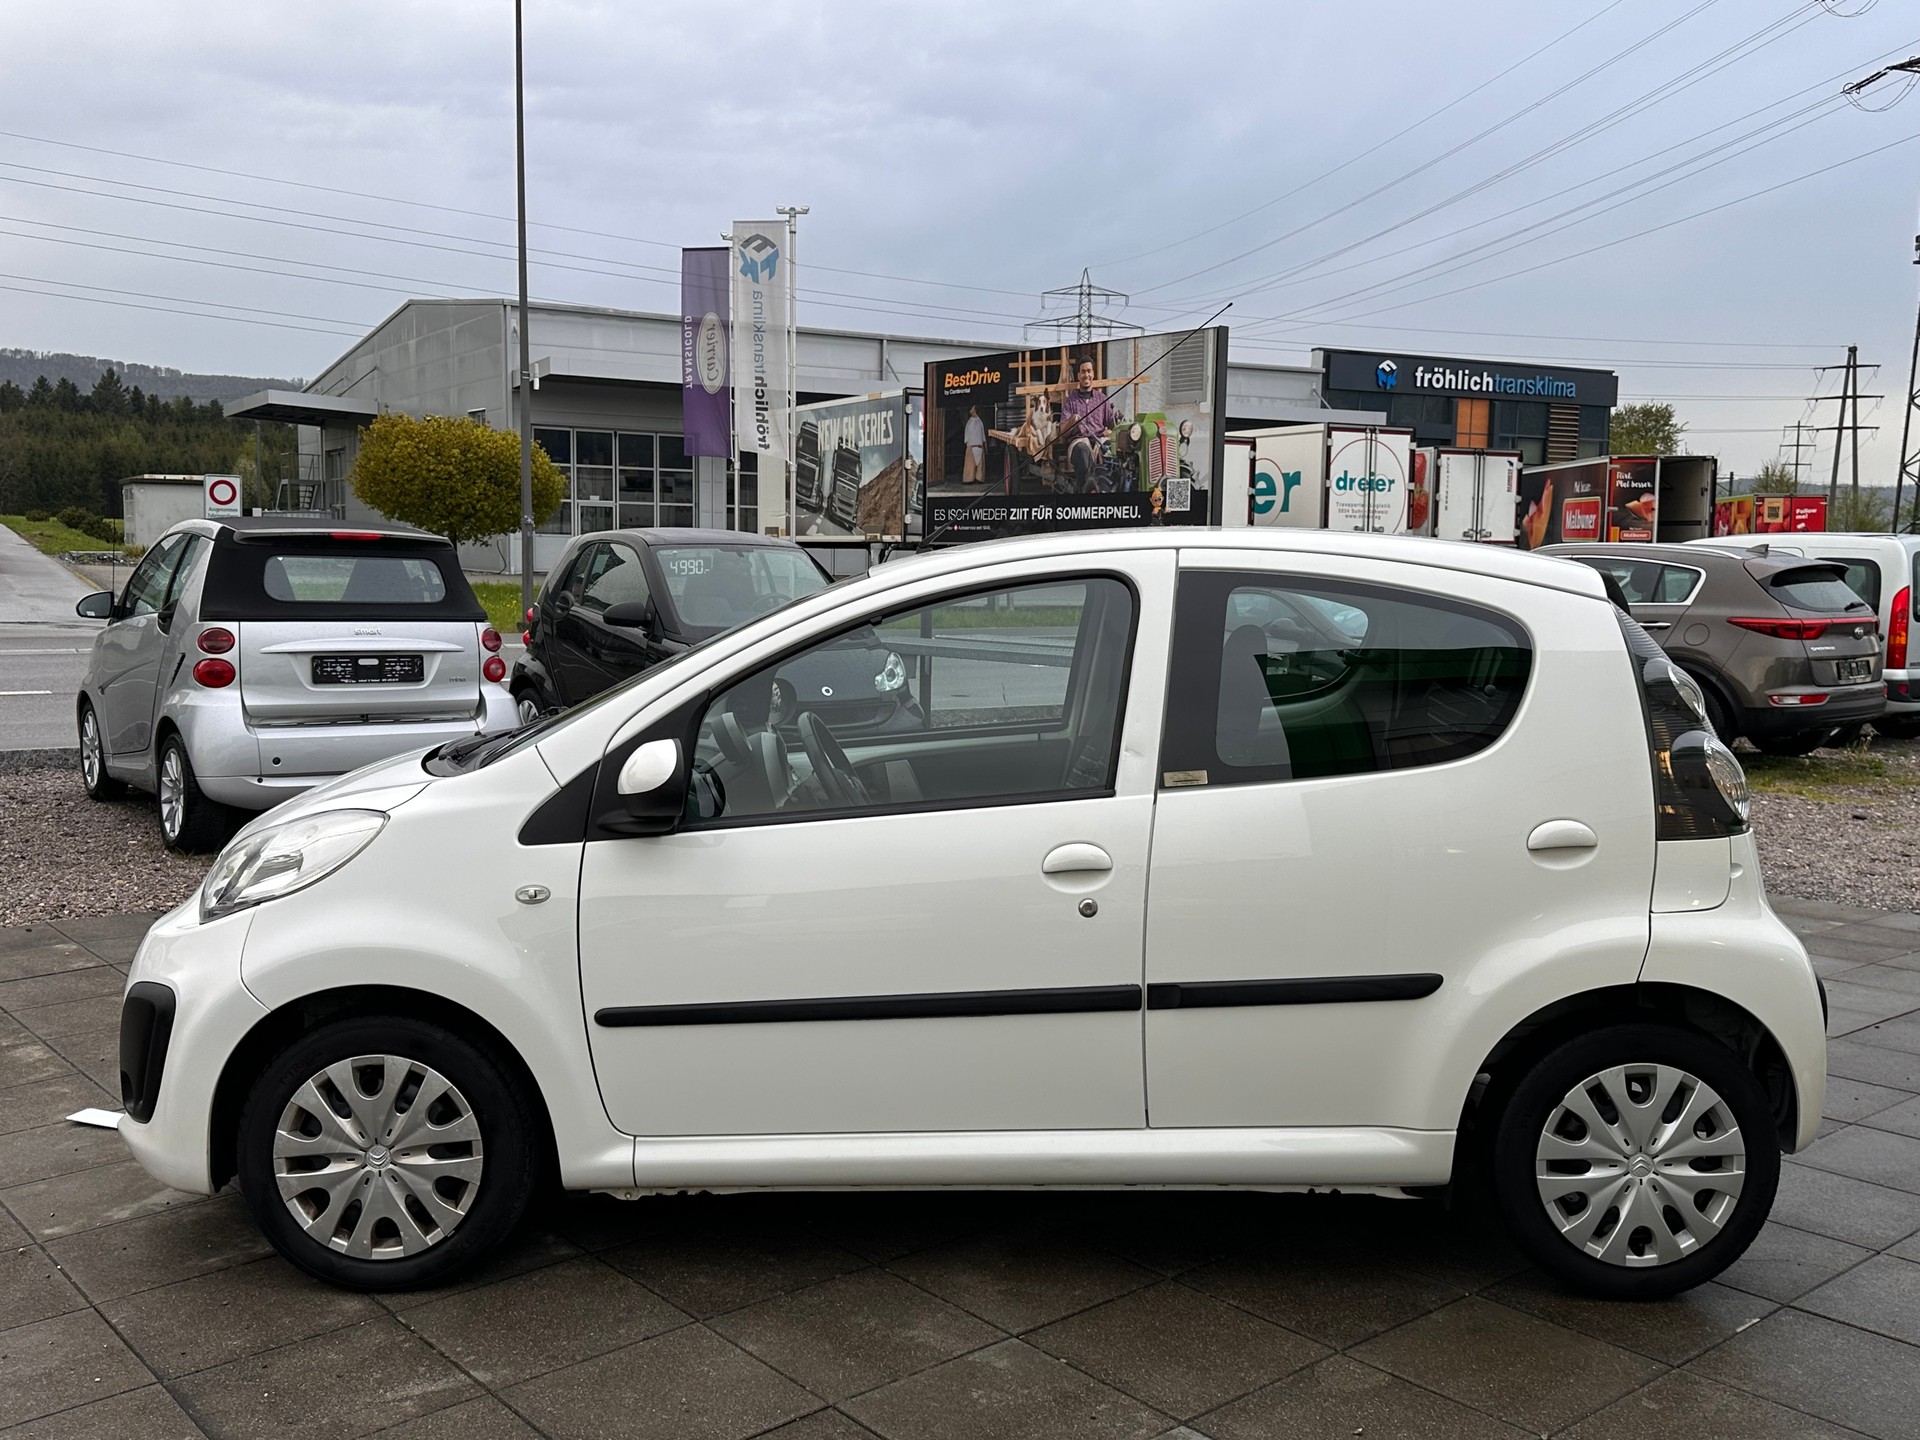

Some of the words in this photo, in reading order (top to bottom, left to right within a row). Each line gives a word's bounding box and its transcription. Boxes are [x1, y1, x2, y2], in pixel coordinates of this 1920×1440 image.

[944, 368, 1001, 388] BestDrive
[1415, 366, 1576, 397] fröhlichtransklima
[818, 417, 840, 452] NEW
[858, 410, 894, 448] SERIES
[1335, 470, 1396, 492] dreier
[934, 508, 946, 520] ES
[948, 508, 969, 521] ISCH
[971, 508, 1008, 520] WIEDER
[1009, 507, 1029, 520] ZIIT
[1031, 505, 1053, 520] FÜR
[1056, 505, 1141, 520] SOMMERPNEU.
[354, 627, 382, 636] smart
